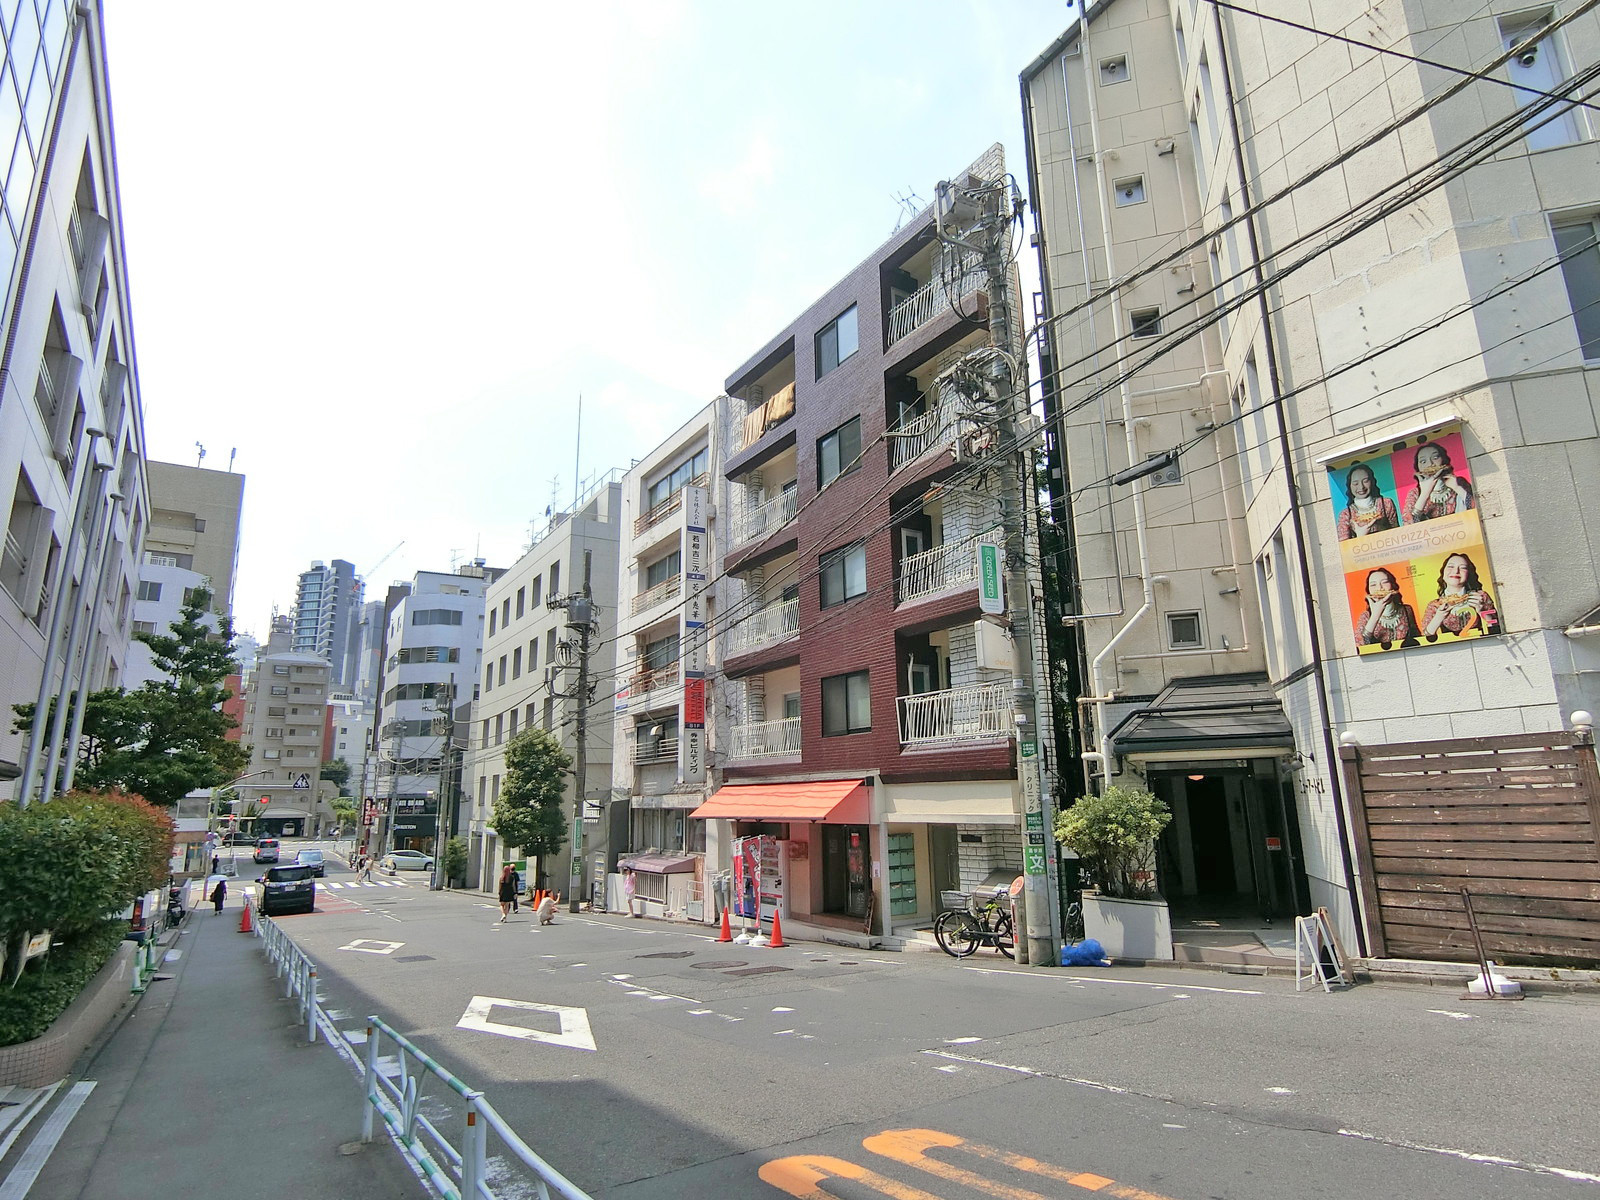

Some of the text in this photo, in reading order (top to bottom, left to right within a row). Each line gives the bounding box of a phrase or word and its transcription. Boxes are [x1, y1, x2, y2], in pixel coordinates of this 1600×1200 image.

[1352, 528, 1431, 555] GOLDEN PIZZA
[1425, 530, 1466, 548] TOKYO
[985, 556, 993, 579] GREEN
[987, 579, 995, 597] SEED
[1456, 607, 1498, 637] 2F
[1026, 776, 1035, 812] クリニック
[1029, 854, 1044, 870] 文
